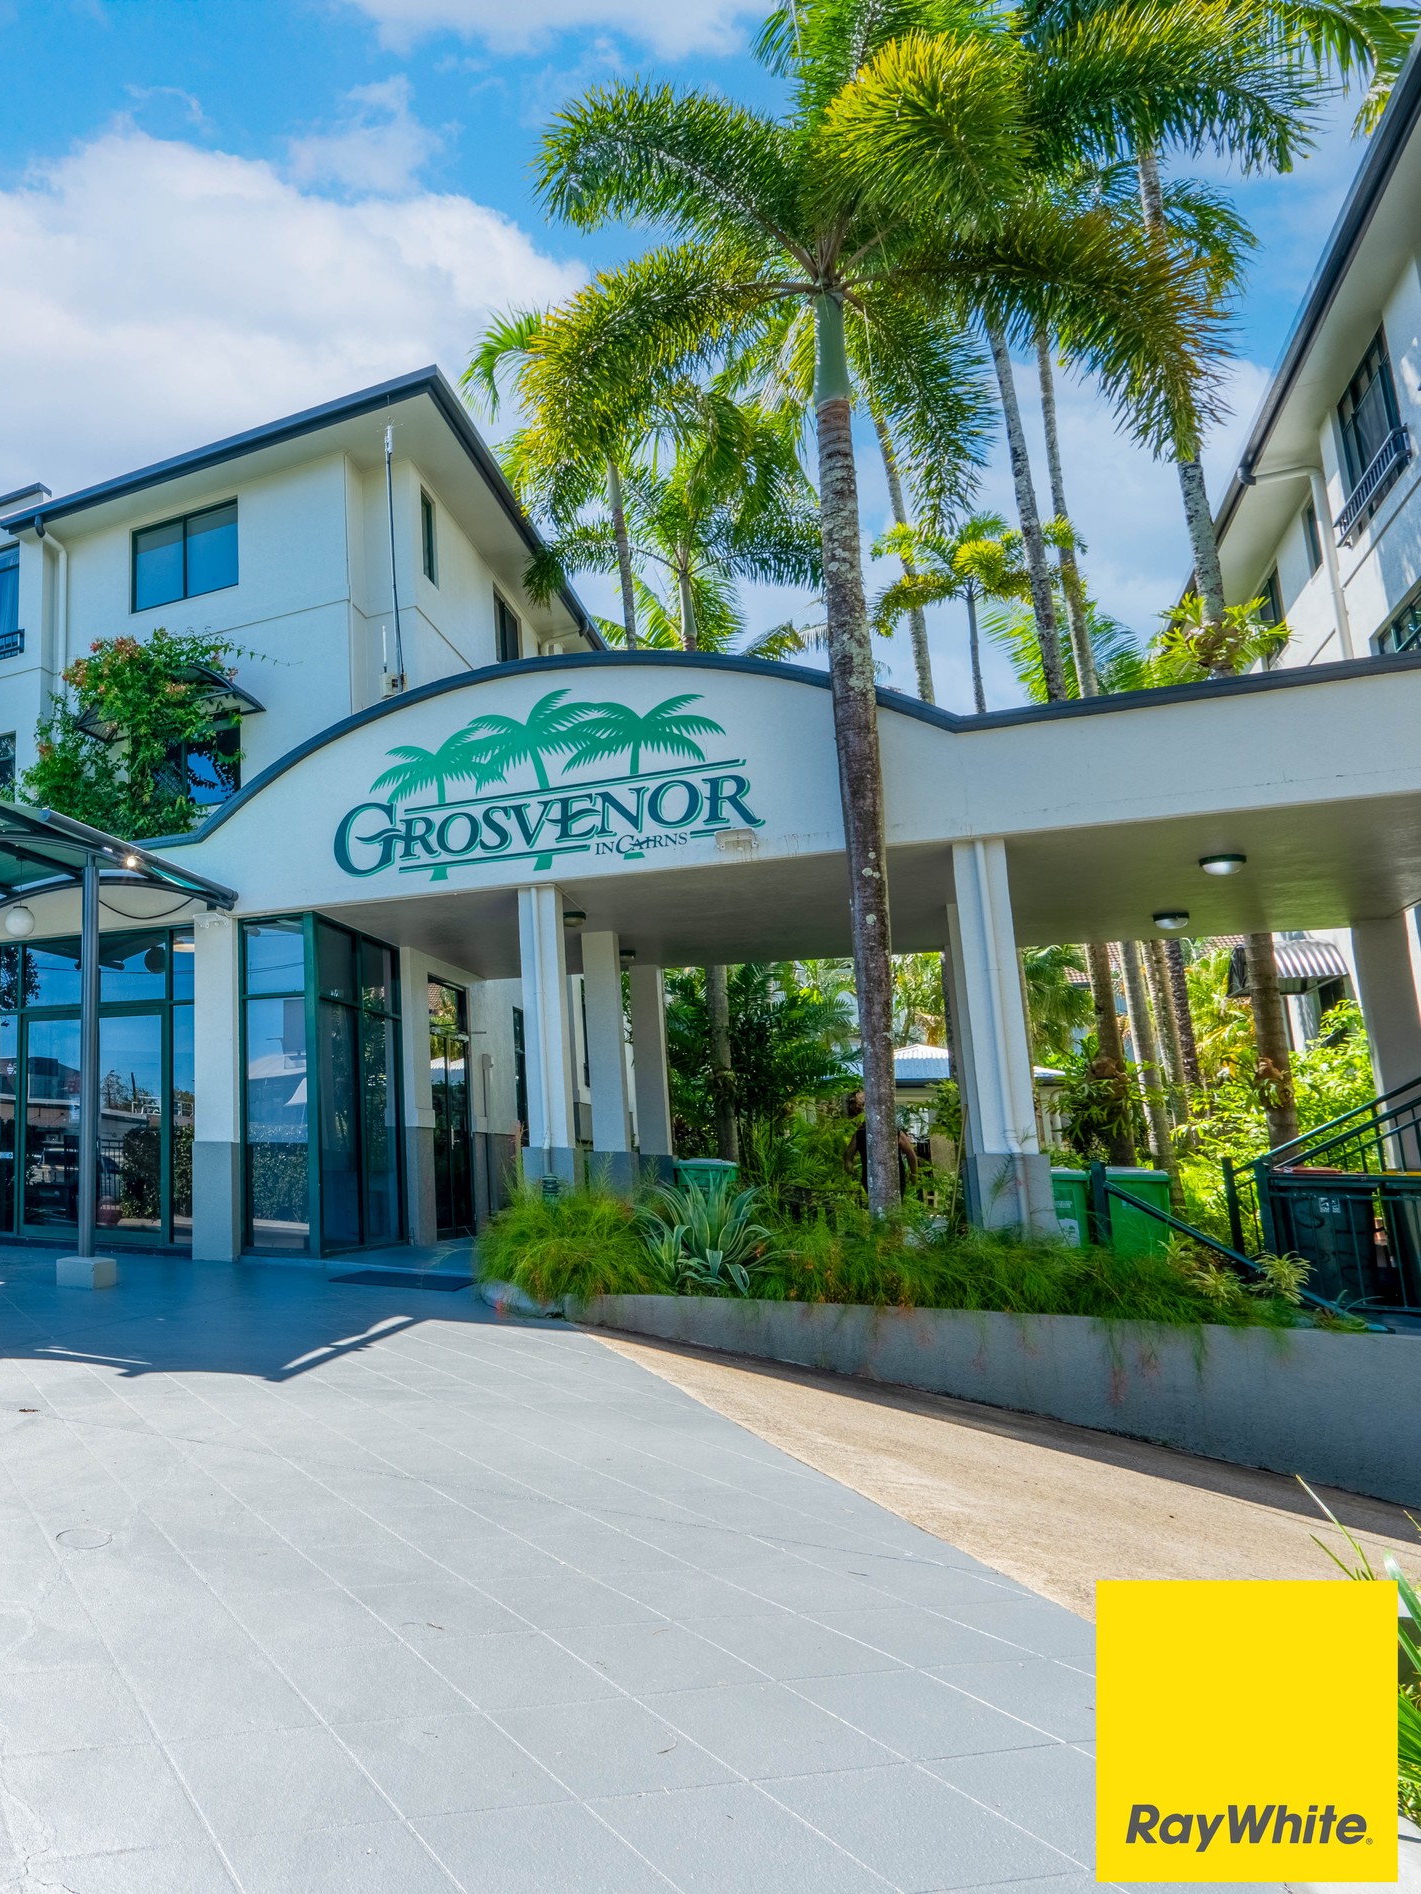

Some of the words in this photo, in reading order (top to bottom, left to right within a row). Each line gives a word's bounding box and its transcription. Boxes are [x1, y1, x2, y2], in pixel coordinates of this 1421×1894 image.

[333, 774, 765, 877] GROSVENOR
[595, 841, 614, 855] IN
[615, 832, 688, 854] CAIRNS
